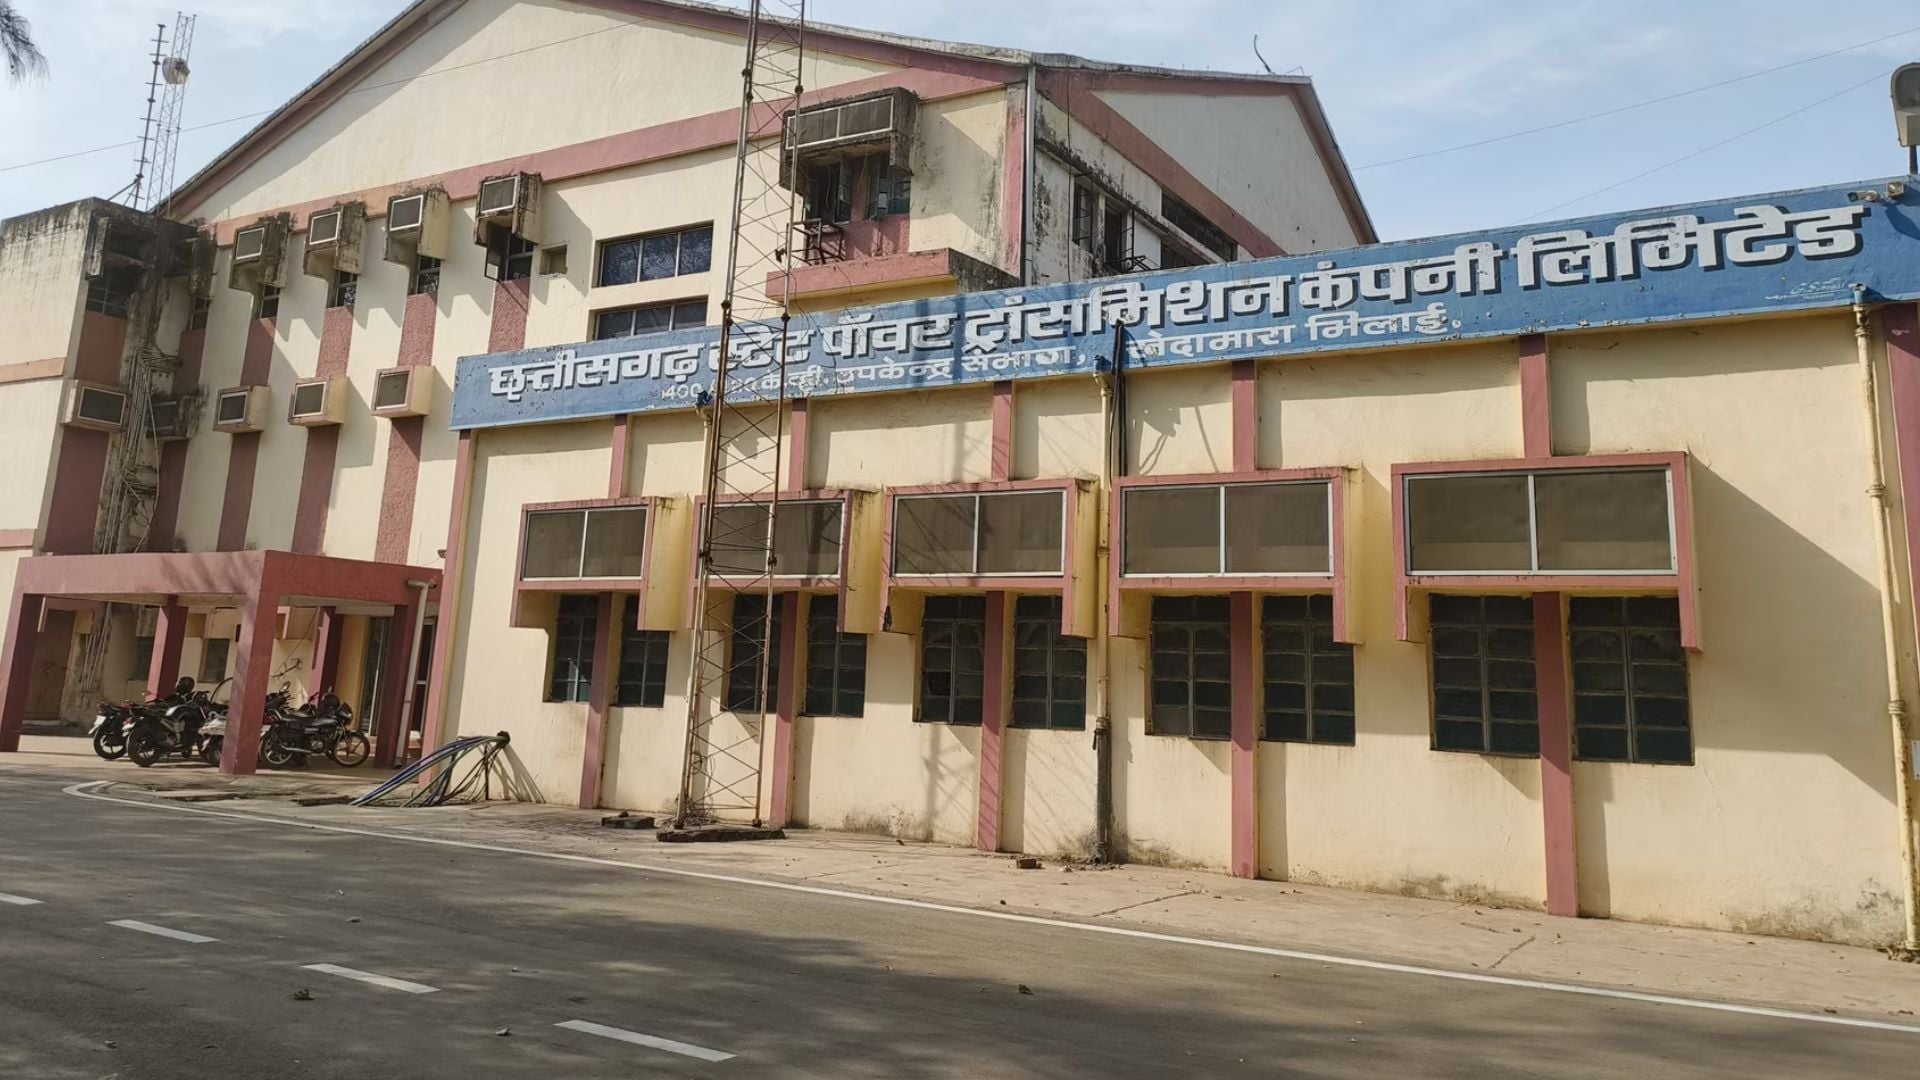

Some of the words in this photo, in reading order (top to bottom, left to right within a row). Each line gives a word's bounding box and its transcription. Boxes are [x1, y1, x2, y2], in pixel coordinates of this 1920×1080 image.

[488, 343, 704, 401] छत्तीसगढ़
[709, 325, 816, 371] स्टेट
[820, 313, 958, 358] पॉवर
[964, 275, 1291, 353] ट्रांसमिशन
[1299, 242, 1502, 309] कंपनी
[1510, 205, 1864, 286] लिमिटेड
[835, 356, 954, 383] उपकेन्द्र
